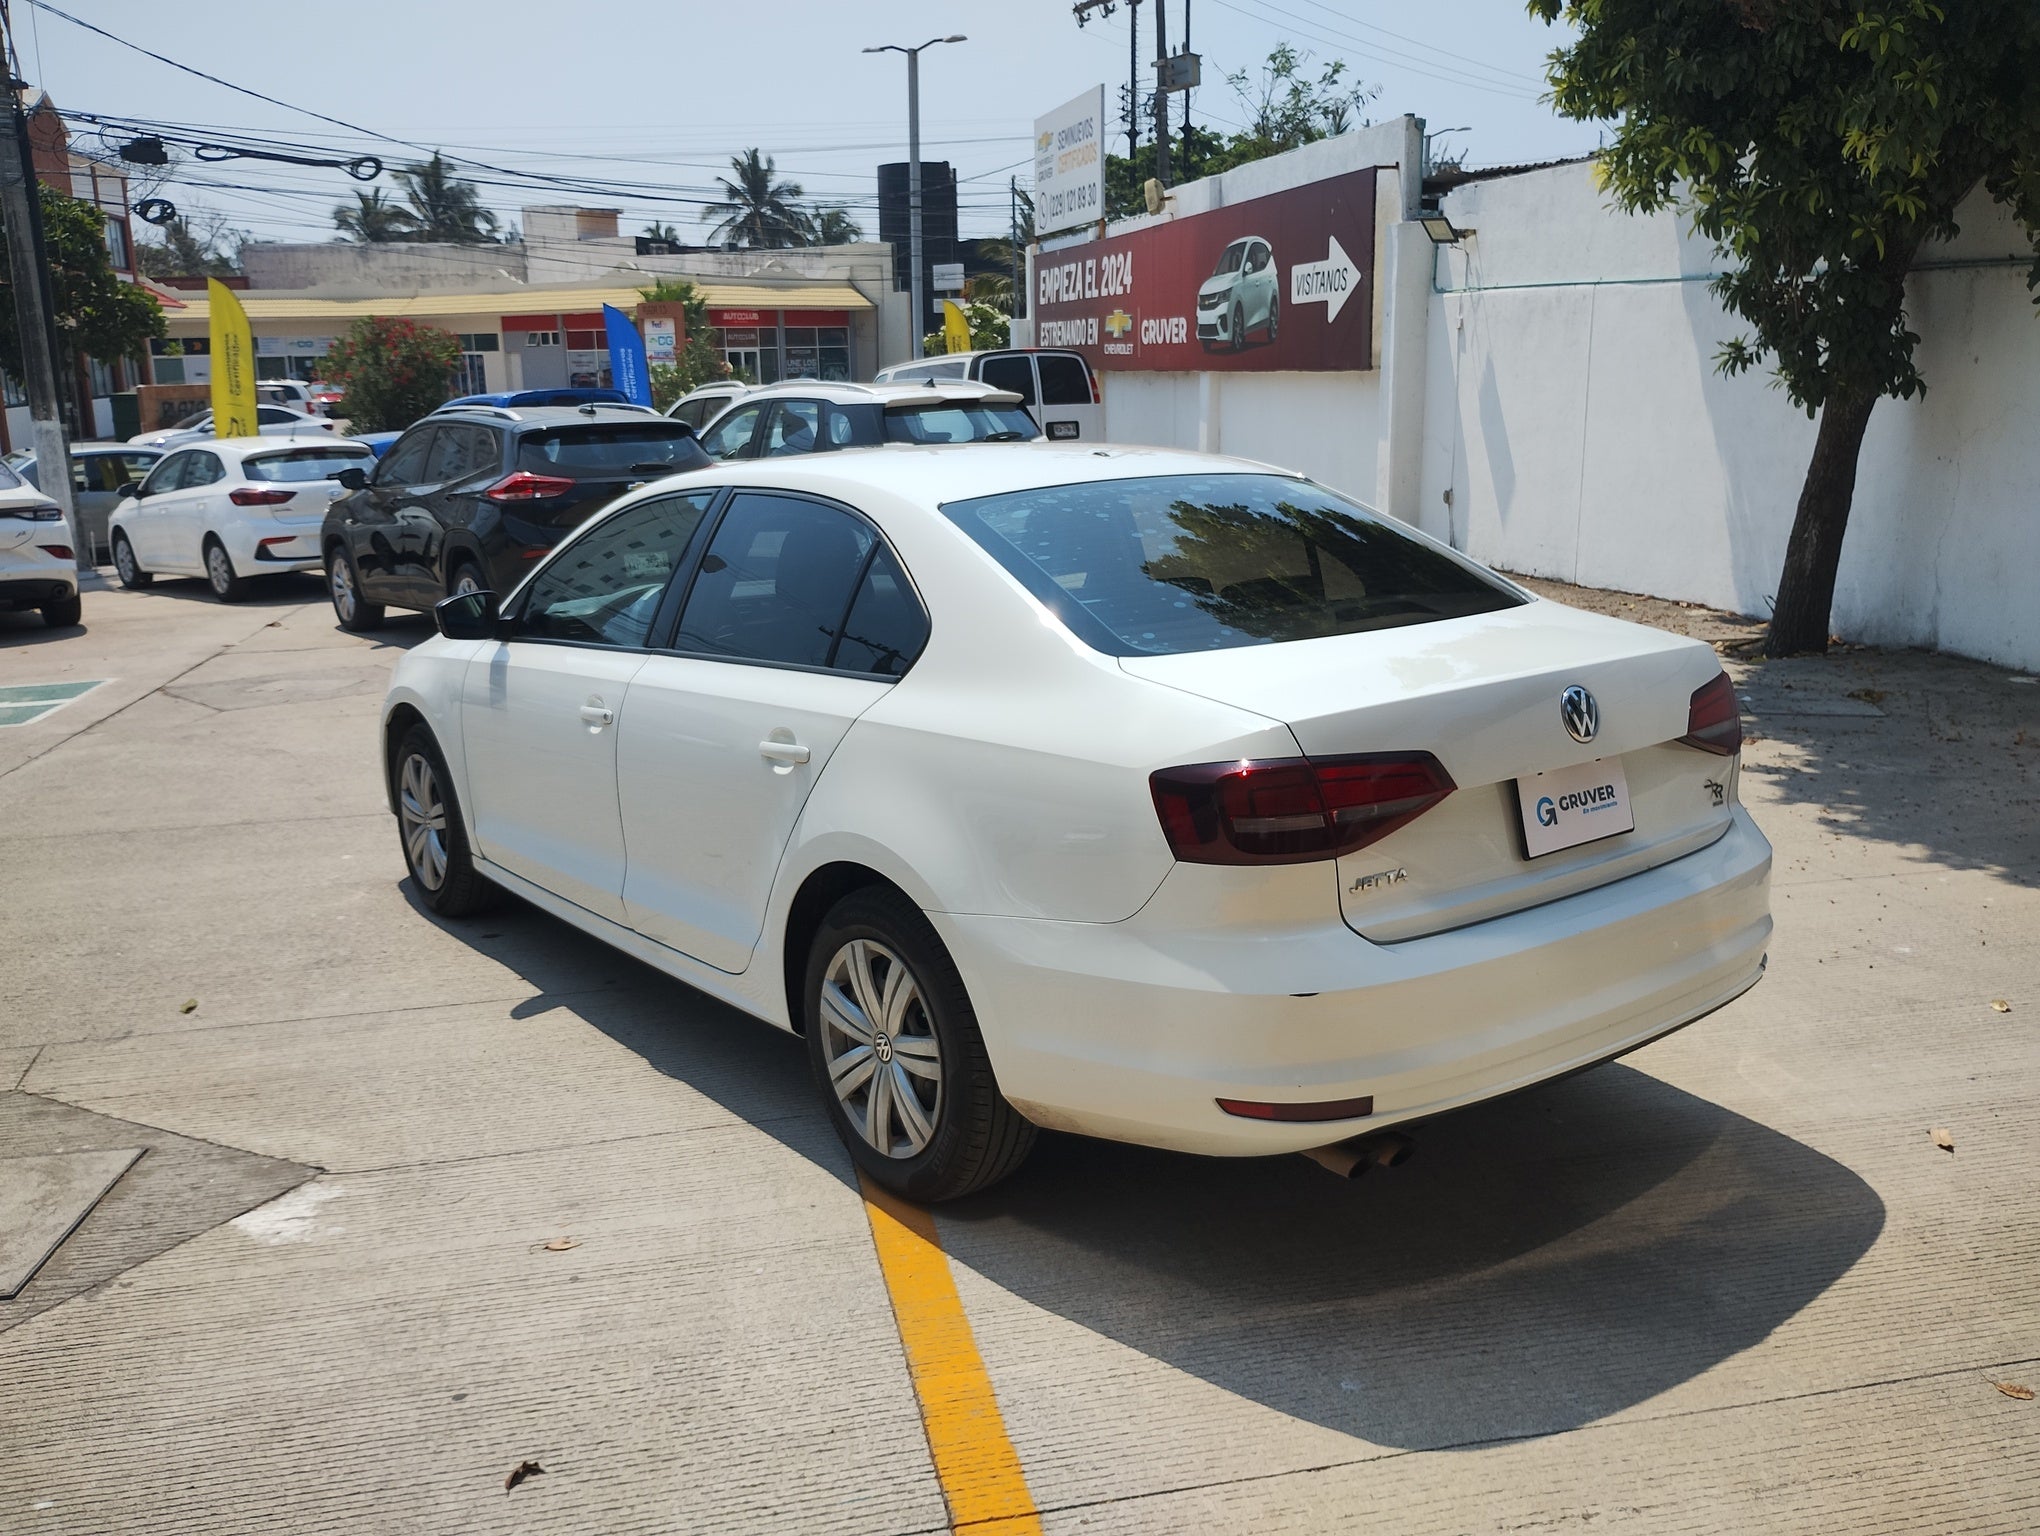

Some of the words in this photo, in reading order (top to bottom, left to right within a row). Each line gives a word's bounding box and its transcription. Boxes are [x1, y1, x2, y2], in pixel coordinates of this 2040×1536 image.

[1067, 189, 1076, 213] 121
[1088, 182, 1097, 206] 30
[1040, 262, 1083, 305] EMPIEZA
[1085, 258, 1099, 299] EL
[1101, 251, 1133, 297] 2024
[1296, 265, 1348, 297] VISÍTANOS
[723, 312, 760, 321] AUTOCLUB
[1041, 319, 1086, 347] ESTRENANDO
[1088, 318, 1099, 345] EN
[1141, 317, 1187, 345] GRUVER
[1104, 343, 1134, 355] CHEVROLET
[1558, 784, 1615, 811] GRUVER
[1349, 867, 1408, 894] JETTA
